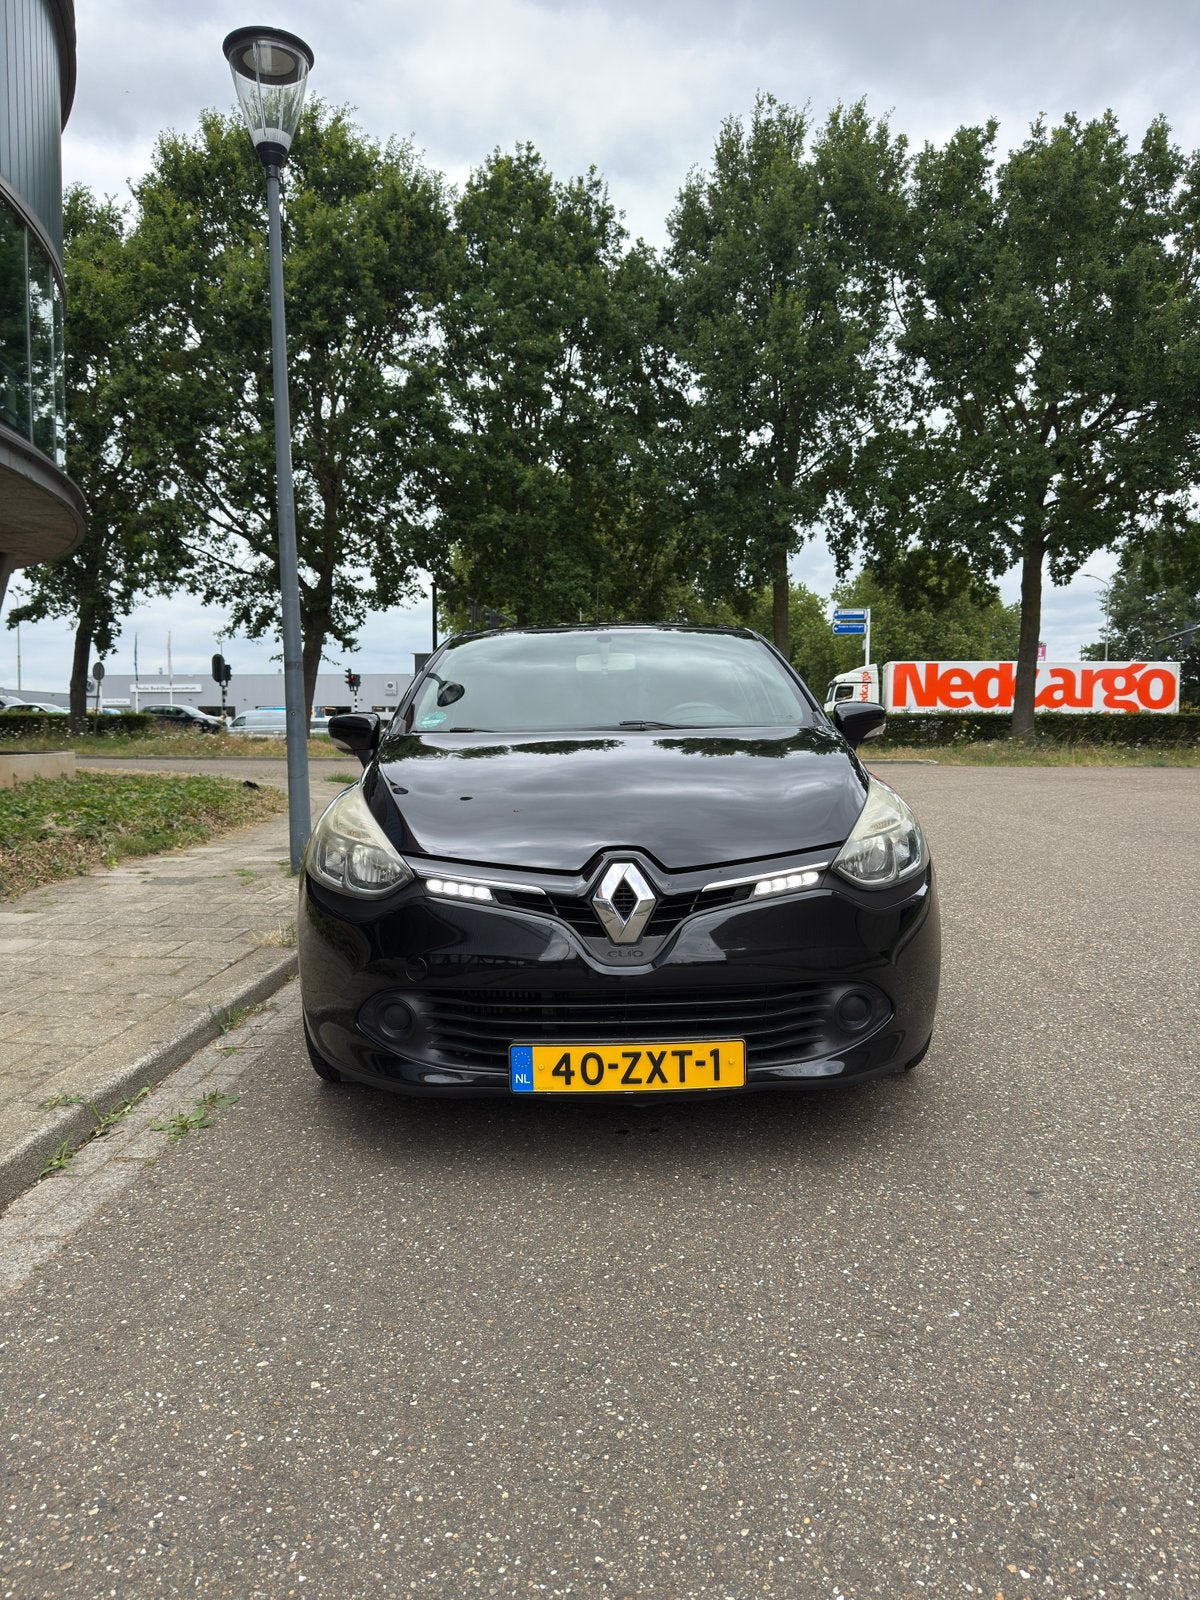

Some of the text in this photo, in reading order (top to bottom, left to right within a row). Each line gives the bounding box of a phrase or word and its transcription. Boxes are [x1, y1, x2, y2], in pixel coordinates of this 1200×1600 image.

[892, 663, 1176, 714] Nedargo
[607, 950, 644, 958] CLIO
[515, 1073, 531, 1084] NL
[551, 1048, 721, 1086] 40-ZXT-1
